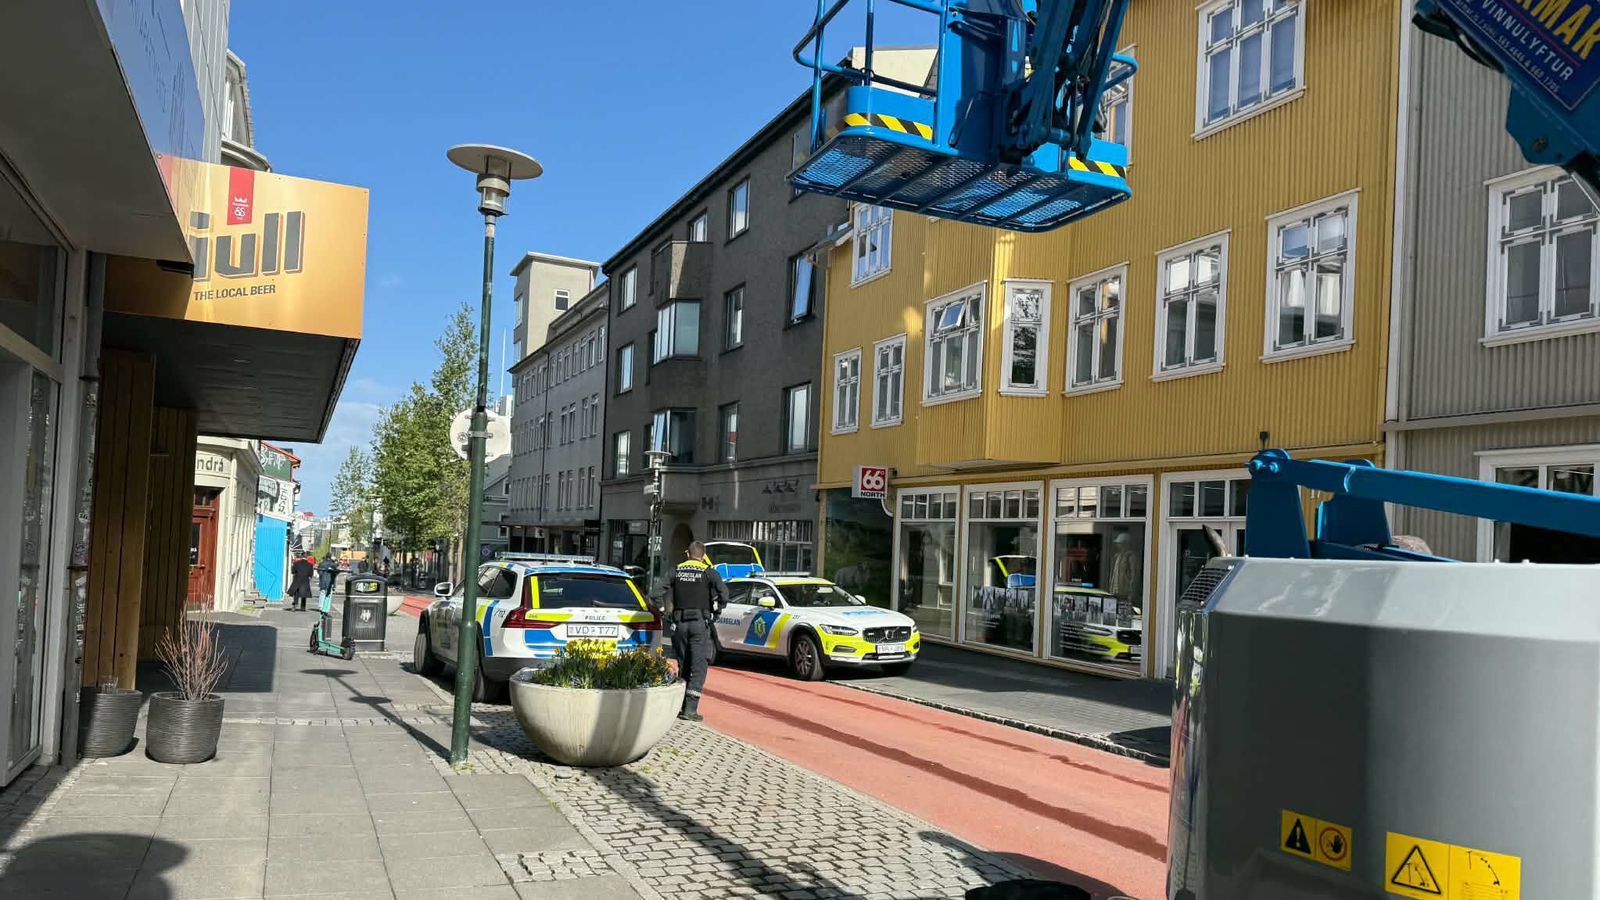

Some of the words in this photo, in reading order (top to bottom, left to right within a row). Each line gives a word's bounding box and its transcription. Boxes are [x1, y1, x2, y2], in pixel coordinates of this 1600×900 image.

[1482, 0, 1574, 81] VINNULYFTUR
[1515, 0, 1600, 60] MAR
[193, 291, 214, 301] THE
[216, 286, 249, 299] LOCAL
[250, 284, 276, 296] BEER
[197, 457, 224, 472] ndrá
